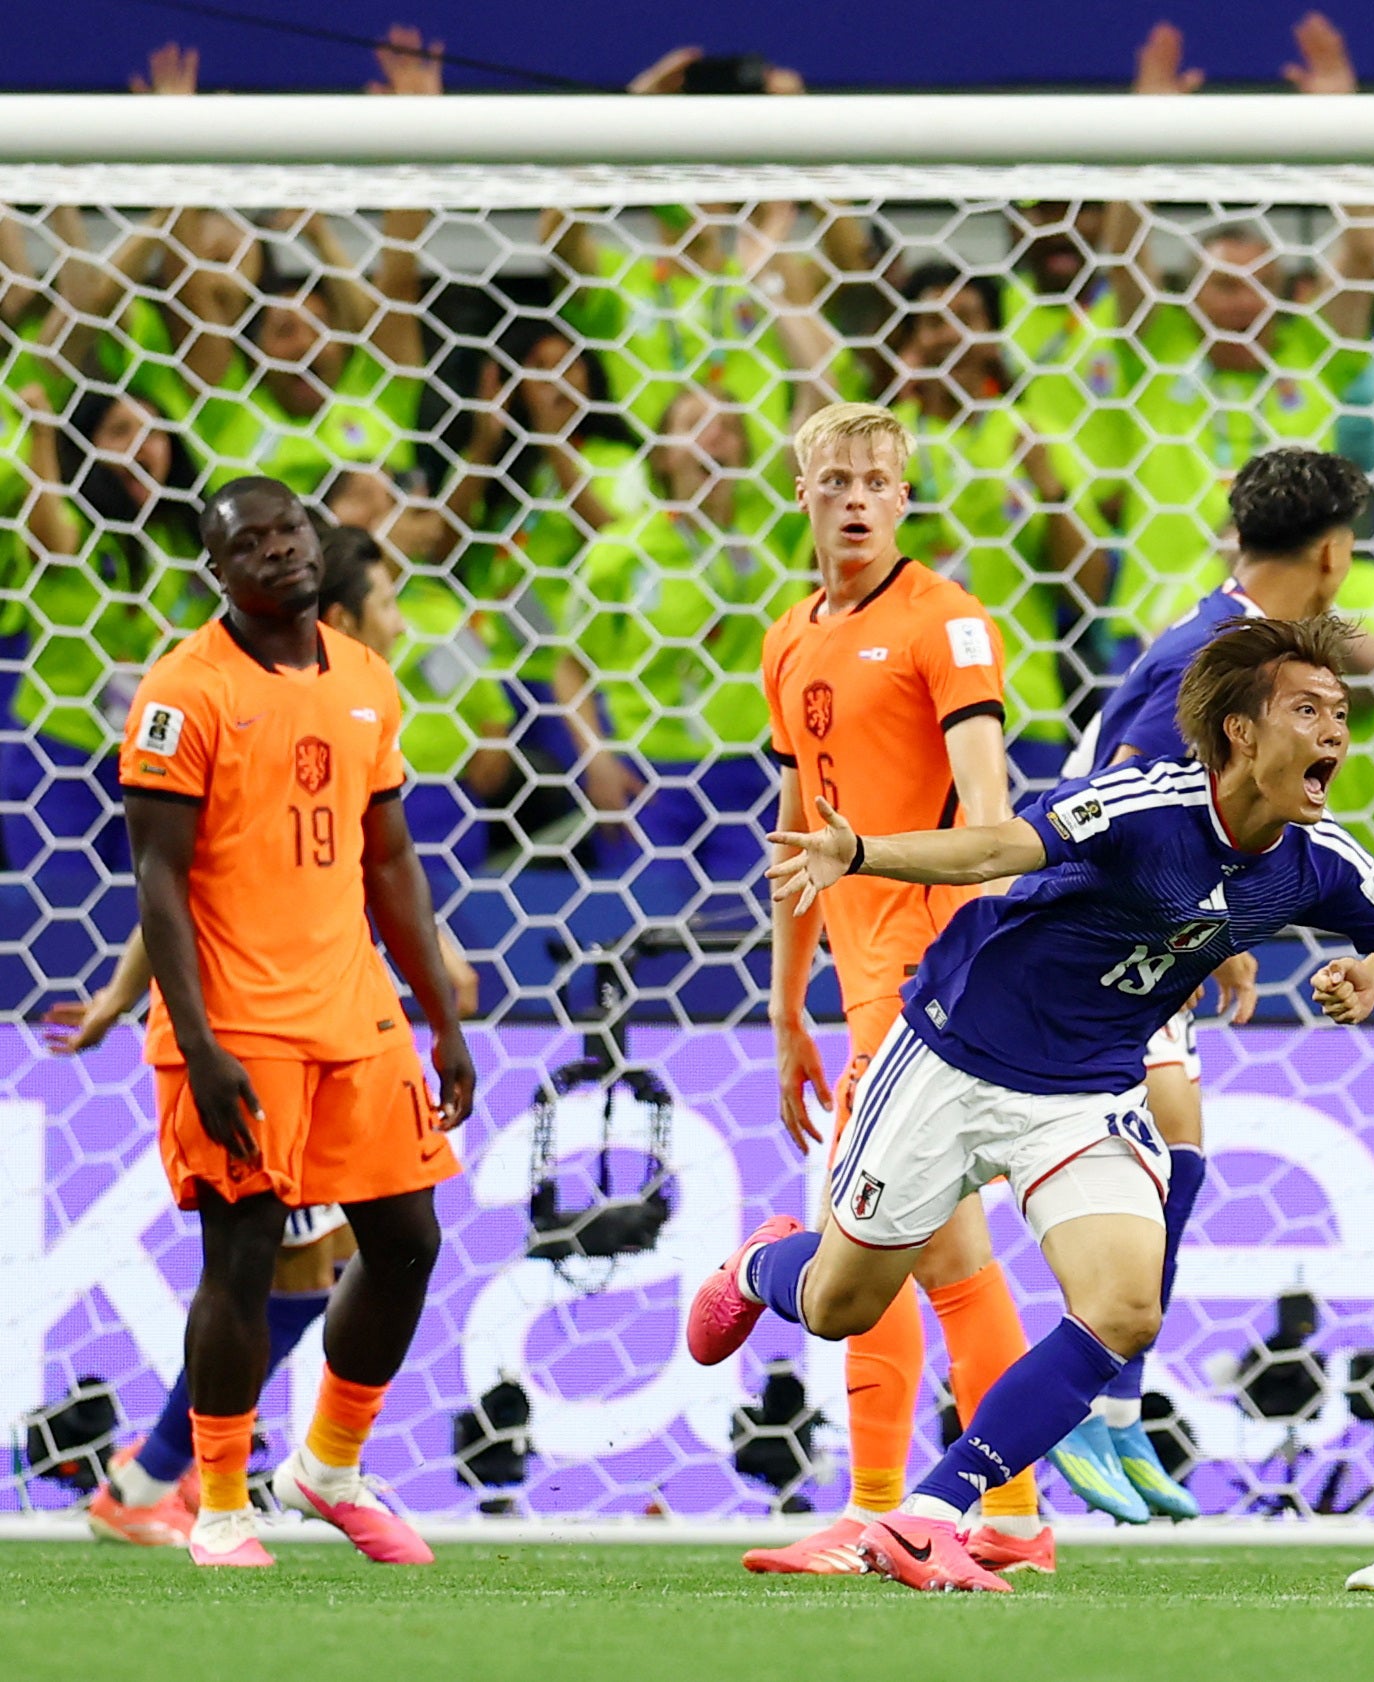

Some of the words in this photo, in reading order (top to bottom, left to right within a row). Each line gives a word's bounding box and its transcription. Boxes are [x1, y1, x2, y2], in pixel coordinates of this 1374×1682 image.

[817, 752, 839, 812] 6
[287, 805, 336, 868] 19
[1100, 945, 1176, 996] 19
[968, 1436, 1013, 1481] JAPA
